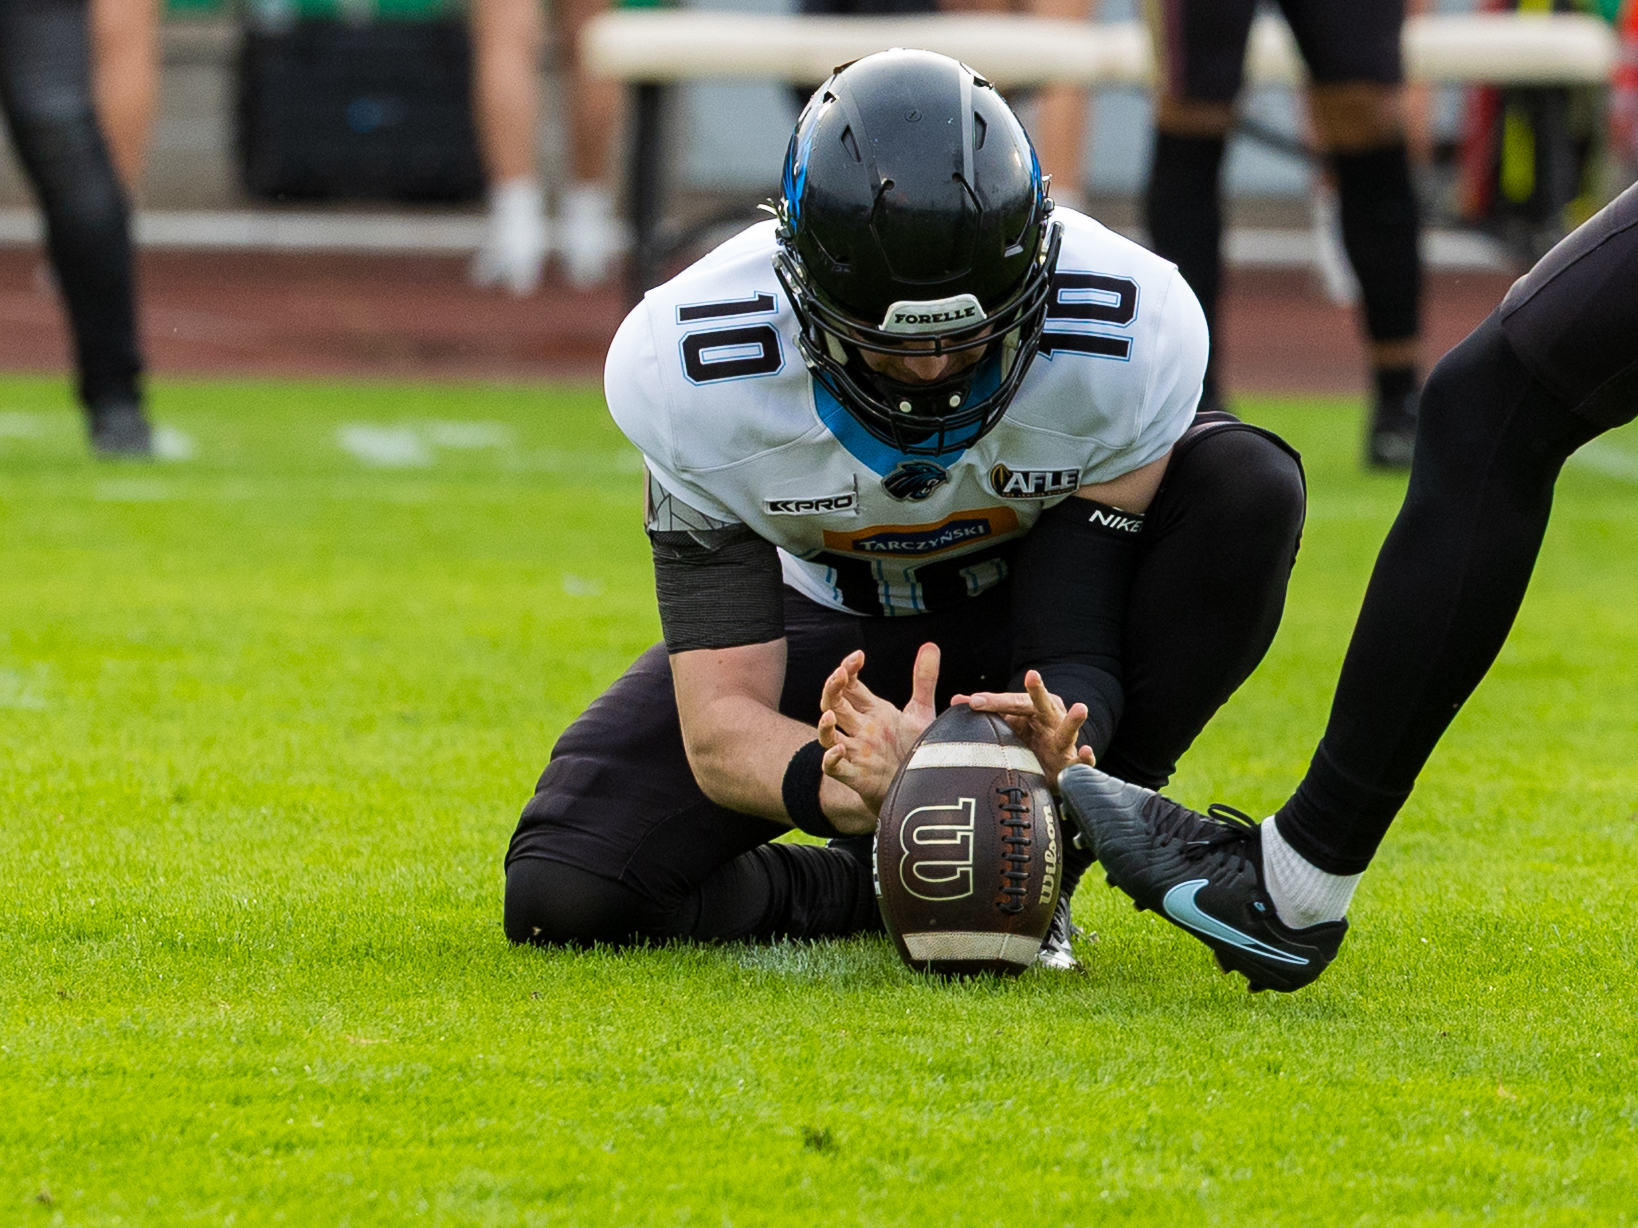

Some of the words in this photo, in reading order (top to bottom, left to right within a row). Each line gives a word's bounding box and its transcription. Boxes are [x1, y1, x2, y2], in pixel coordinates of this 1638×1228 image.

[894, 306, 976, 325] FORELLE
[1037, 269, 1141, 362] 10
[675, 290, 786, 387] 10
[1002, 470, 1078, 494] AFLE
[1088, 509, 1143, 534] NIKE
[859, 524, 985, 551] TARCZYŃSKI
[1038, 804, 1059, 906] Wilson
